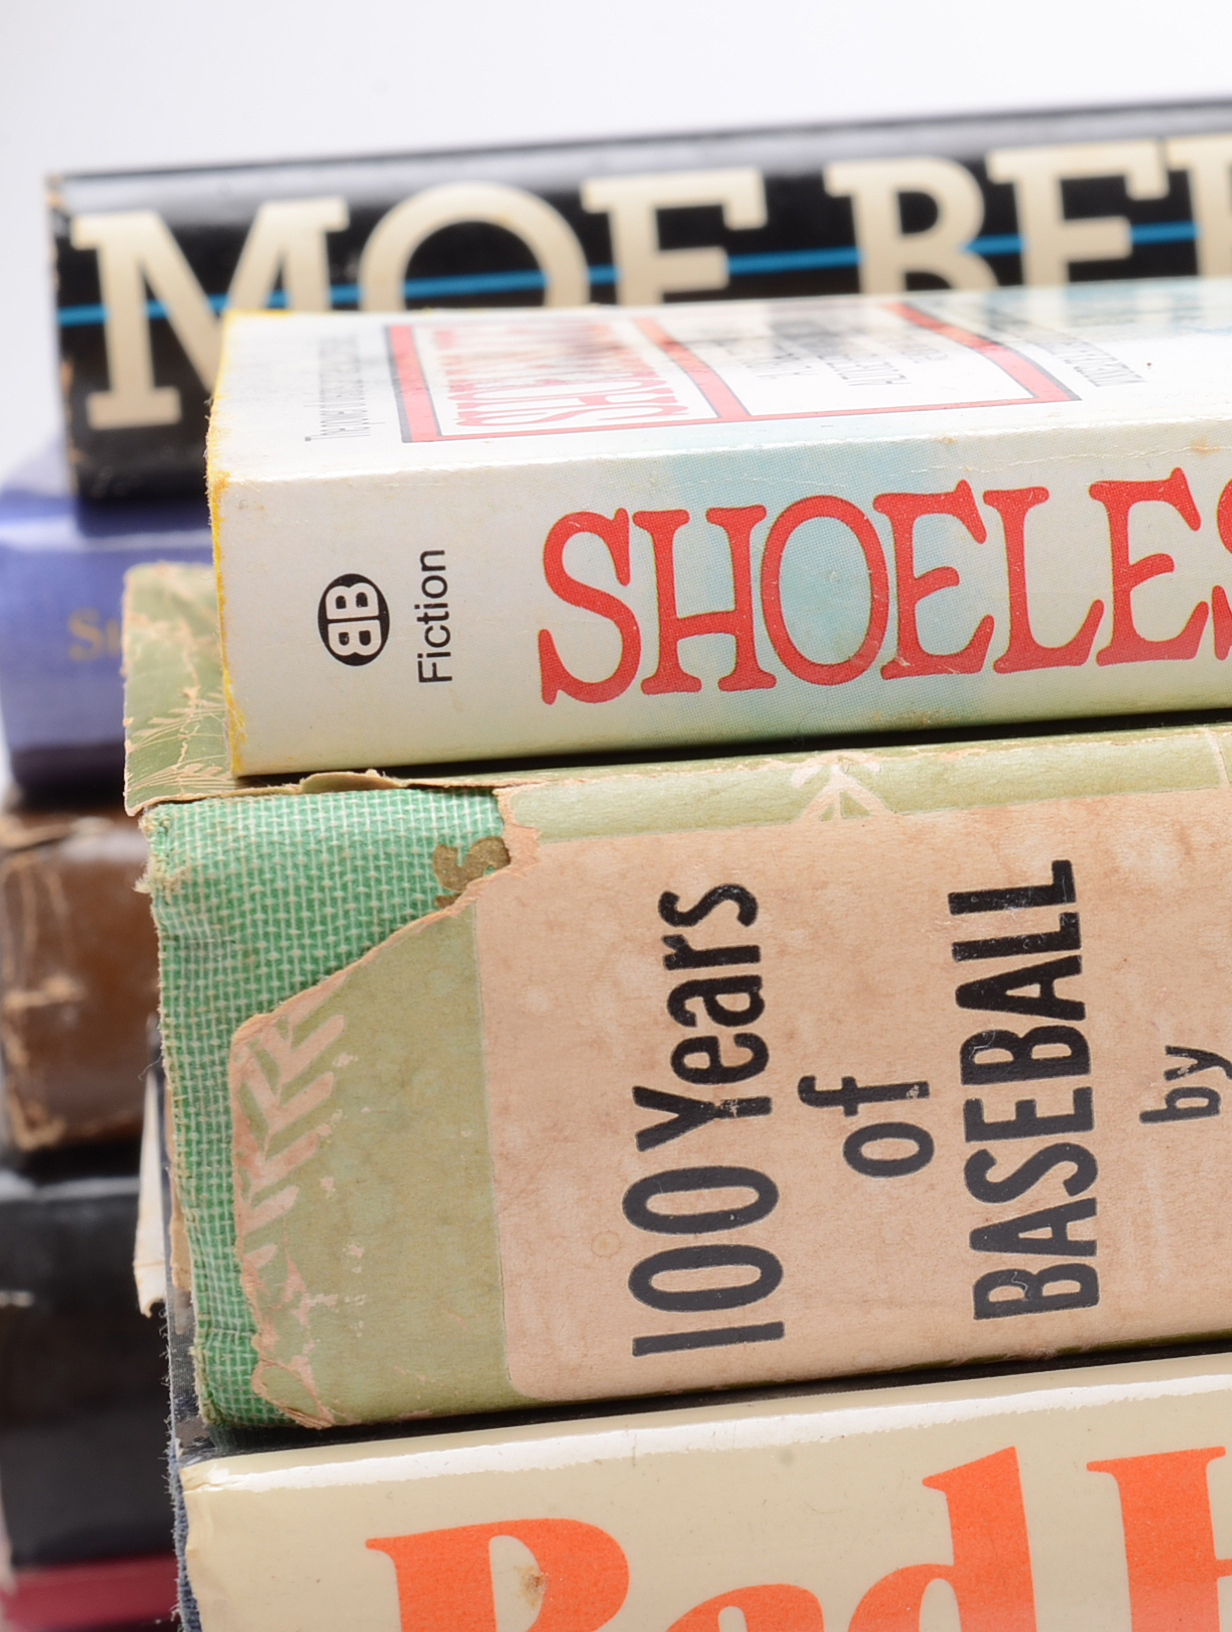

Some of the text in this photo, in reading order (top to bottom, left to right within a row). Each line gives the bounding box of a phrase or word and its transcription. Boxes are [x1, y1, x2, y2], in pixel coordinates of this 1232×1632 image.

[414, 549, 453, 683] Fiction
[632, 883, 774, 1152] Years
[948, 859, 1100, 1321] BASEBALL
[798, 1074, 936, 1178] of
